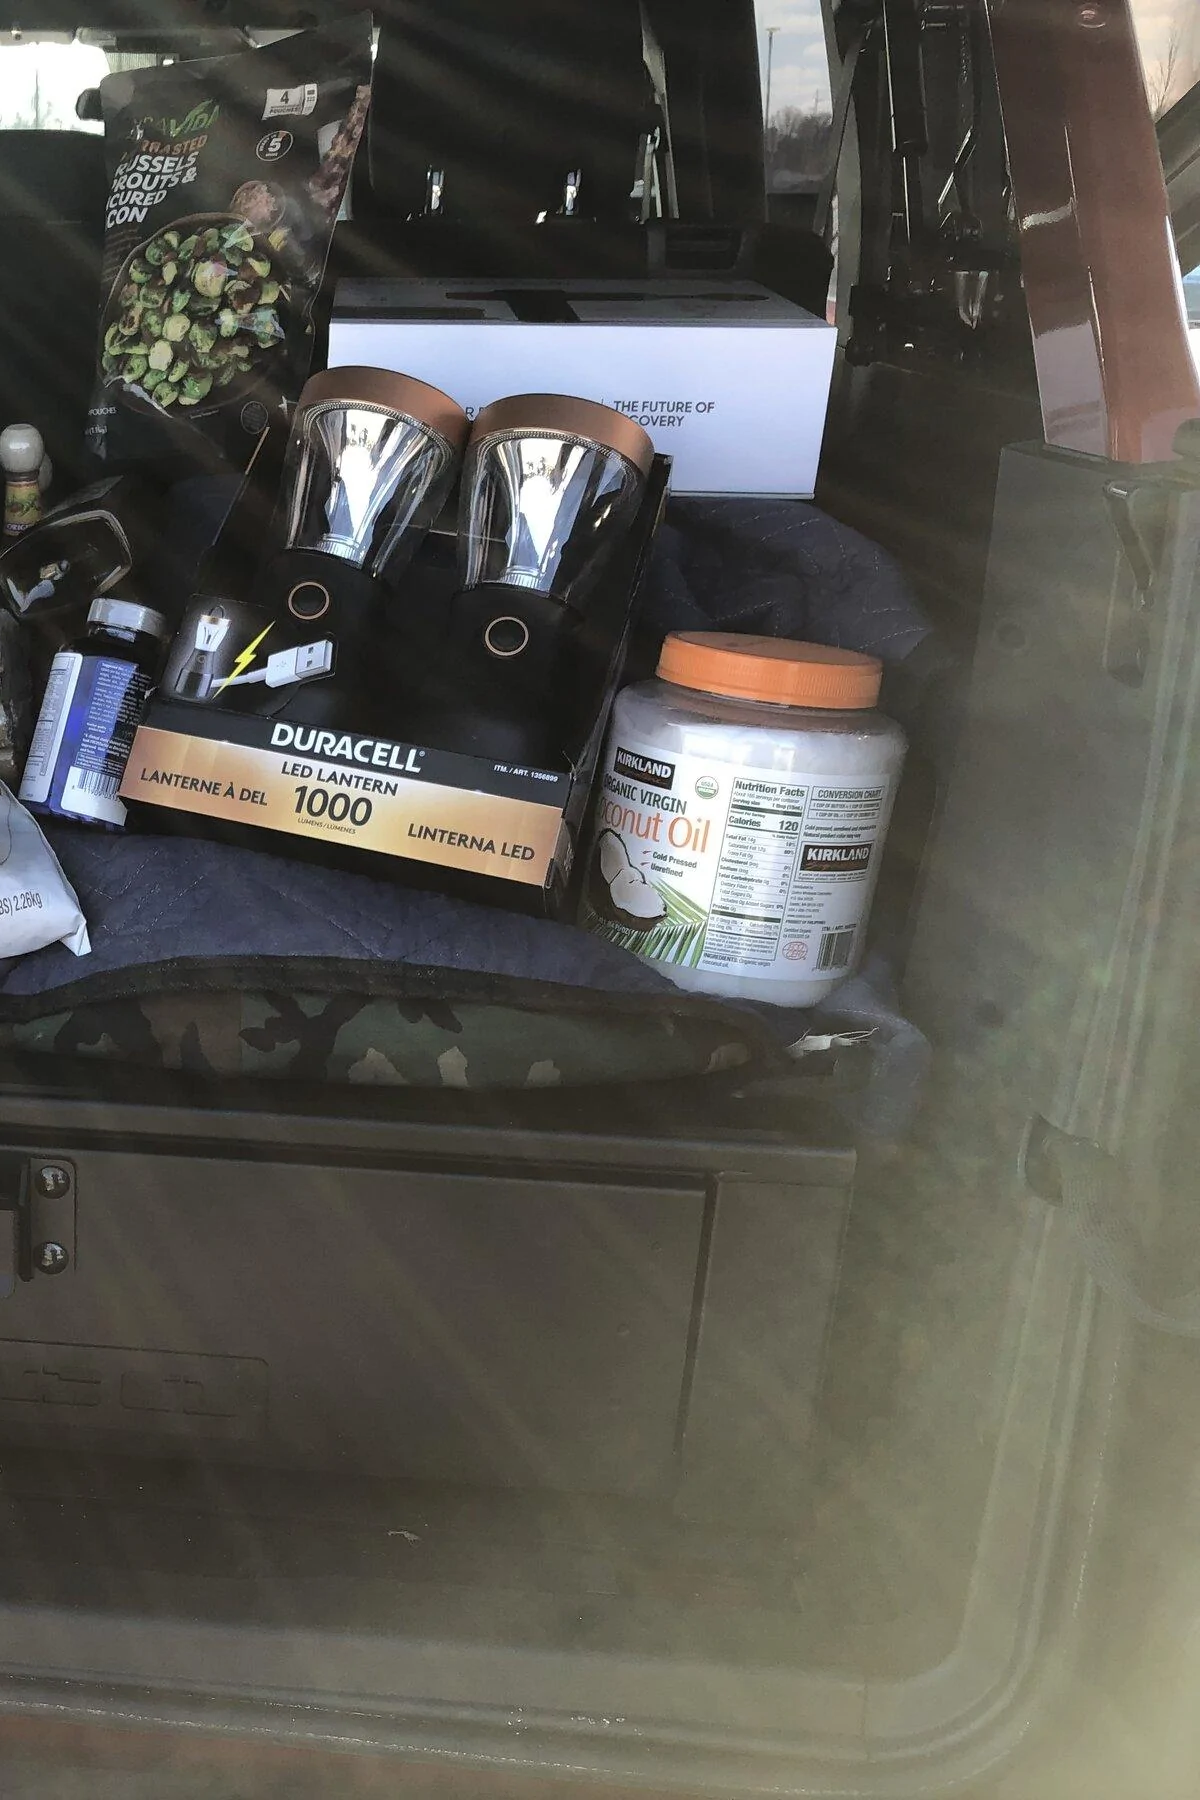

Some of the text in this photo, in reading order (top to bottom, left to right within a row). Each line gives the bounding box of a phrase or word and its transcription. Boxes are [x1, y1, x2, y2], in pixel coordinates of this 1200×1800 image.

[280, 91, 289, 104] 4
[268, 138, 281, 152] 5
[182, 167, 197, 183] &
[613, 400, 715, 413] THE FUTURE OF
[270, 723, 422, 774] DURACELL
[617, 751, 672, 779] KIRKLAND
[140, 768, 222, 796] LANTERNE
[223, 782, 236, 800] À
[239, 787, 269, 807] DEL
[281, 761, 399, 797] LED LANTERN
[735, 780, 805, 797] Nutrition Facts
[818, 789, 863, 799] CONVERSION
[293, 785, 373, 827] 1000
[640, 789, 687, 815] VIRGIN
[729, 816, 799, 832] Calories 120
[408, 823, 535, 862] LINTERNA LED
[668, 816, 711, 853] Oil
[652, 851, 698, 869] Cold Pressed
[806, 847, 869, 861] KIRKLAND
[651, 863, 684, 878] Unrefined
[13, 892, 43, 911] 2.26kg
